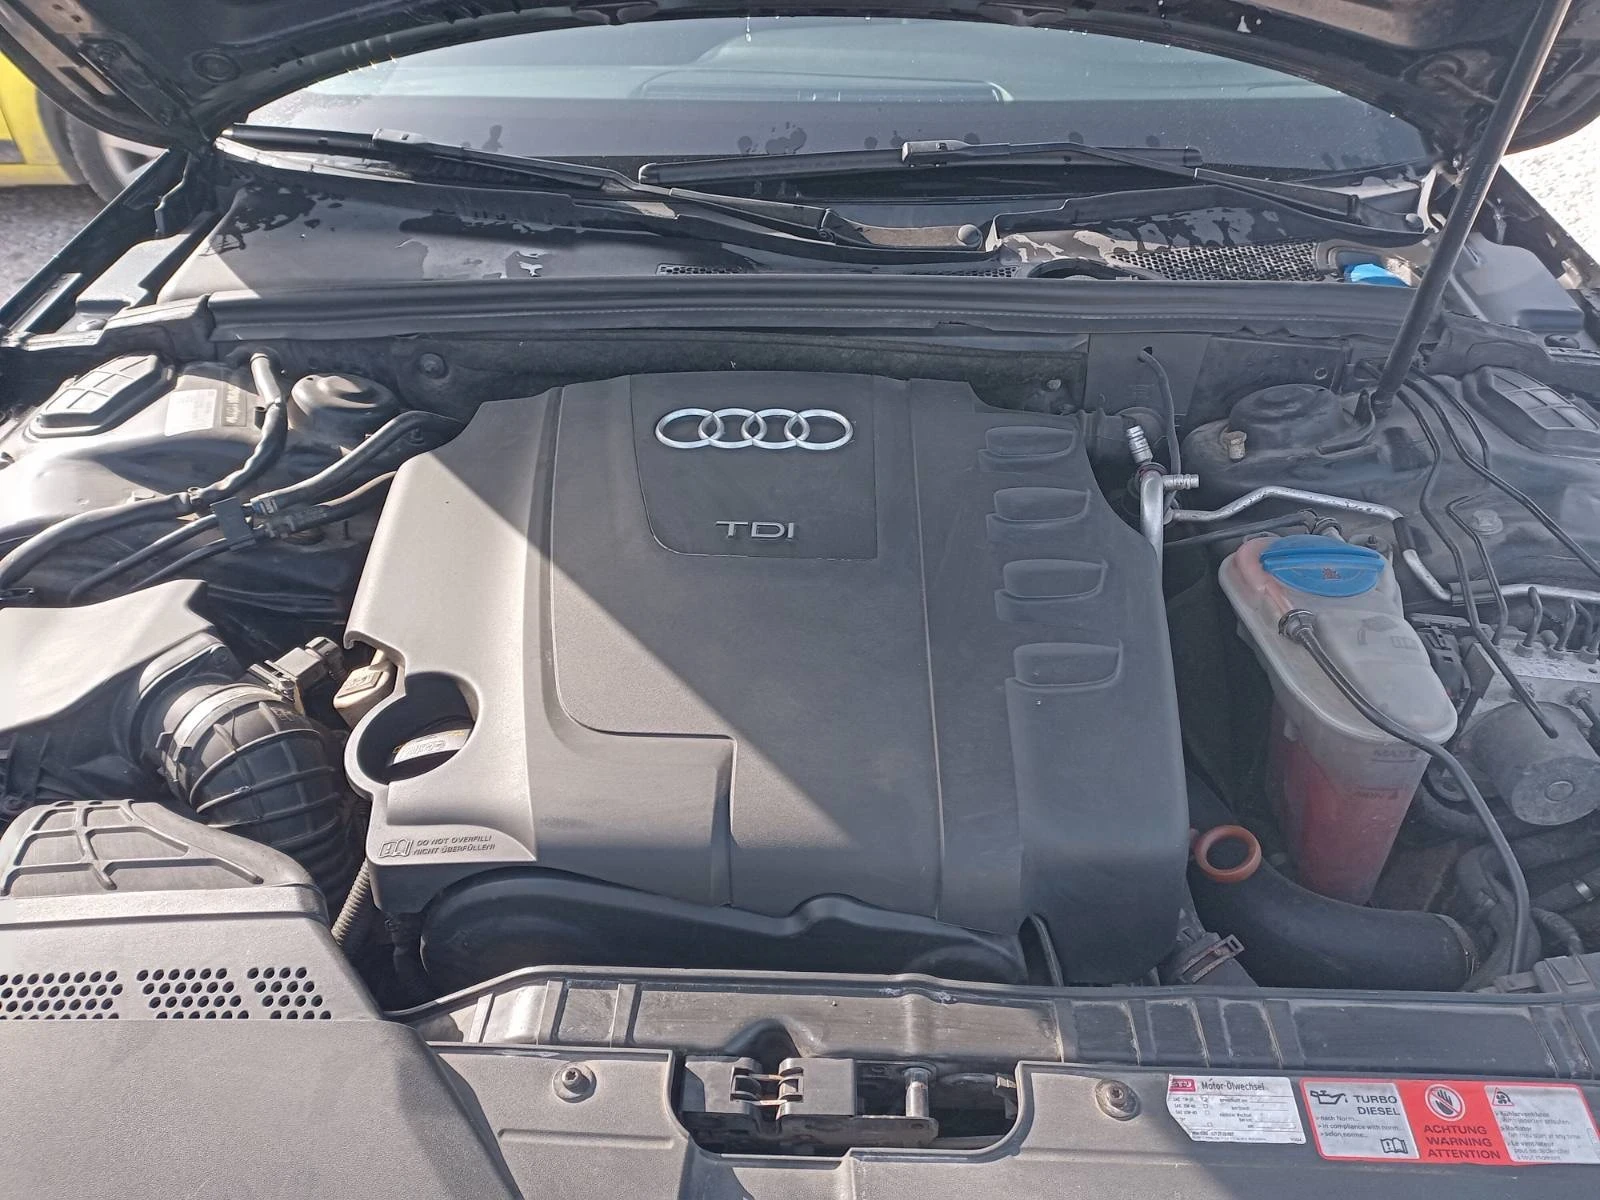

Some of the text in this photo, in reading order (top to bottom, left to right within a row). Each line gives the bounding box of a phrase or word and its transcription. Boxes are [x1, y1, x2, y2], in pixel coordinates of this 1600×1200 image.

[715, 520, 795, 539] TDI
[416, 839, 430, 847] DO
[413, 847, 440, 856] NICHT
[1353, 1095, 1398, 1104] TURBO
[1357, 1106, 1401, 1116] DIESEL
[1423, 1124, 1488, 1135] ACHTUNG
[1425, 1136, 1493, 1147] WARNING
[1428, 1148, 1501, 1159] ATTENTION
